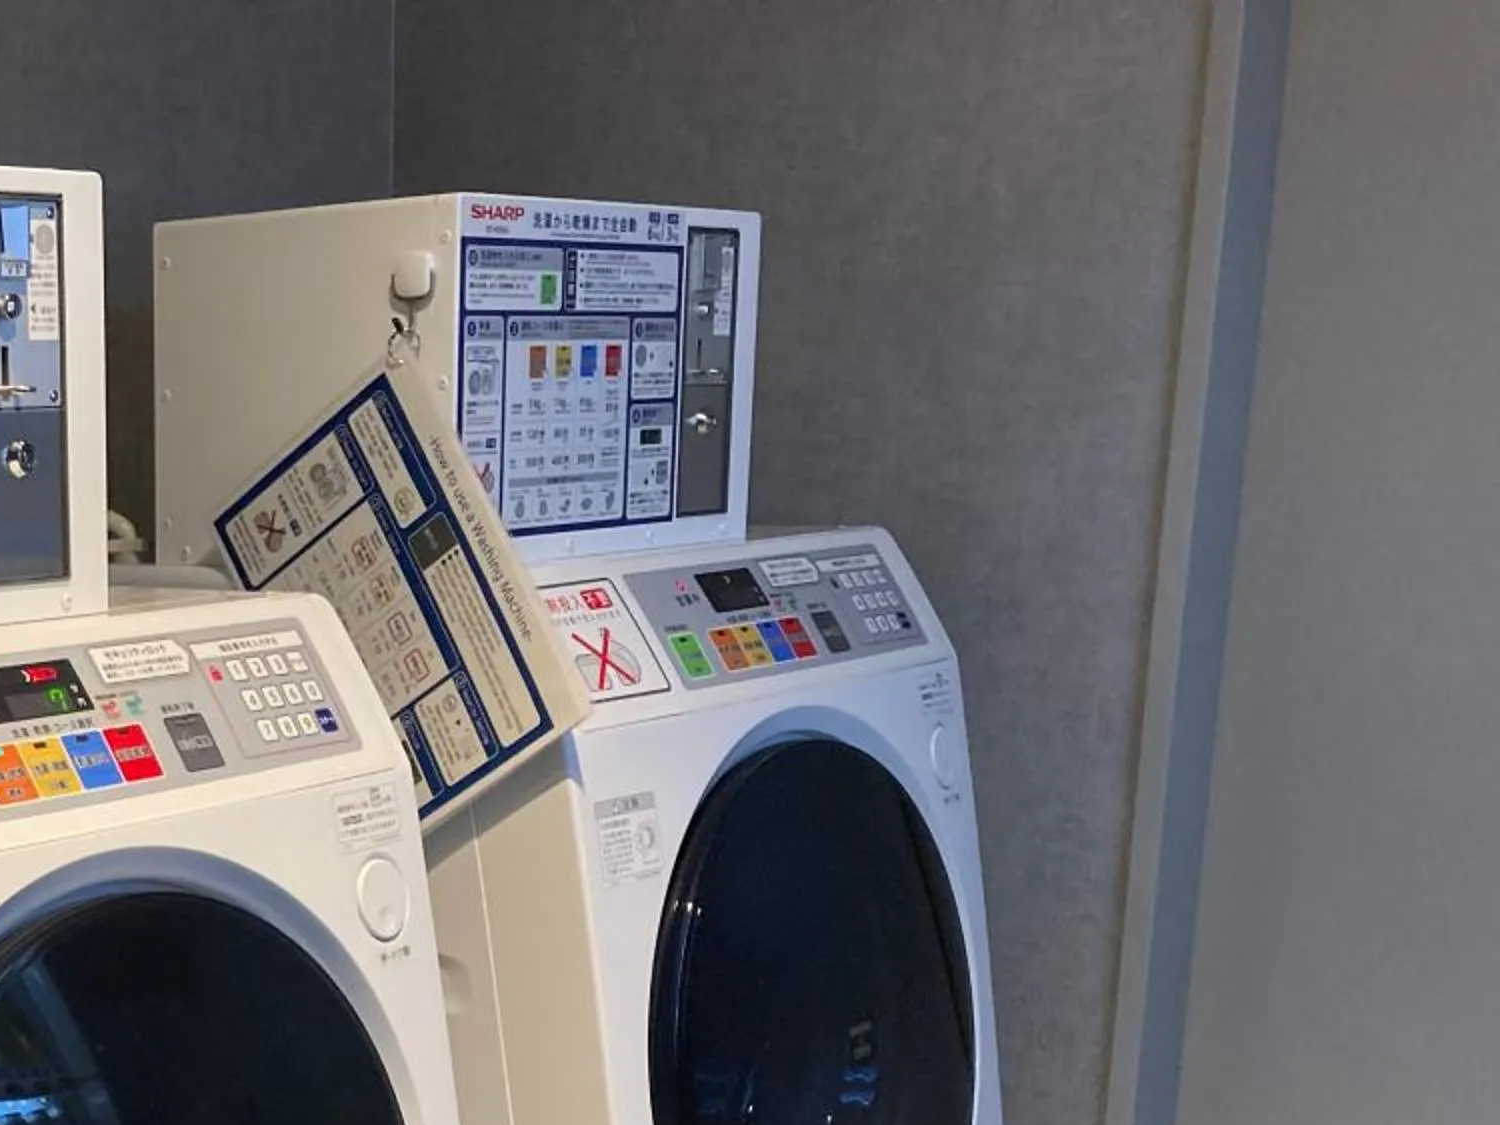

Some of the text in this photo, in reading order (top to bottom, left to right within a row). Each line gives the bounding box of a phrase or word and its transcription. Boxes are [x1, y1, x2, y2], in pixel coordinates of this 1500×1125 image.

[471, 204, 525, 220] SHARP
[446, 469, 455, 487] to
[453, 486, 470, 513] use
[471, 522, 505, 583] Washing
